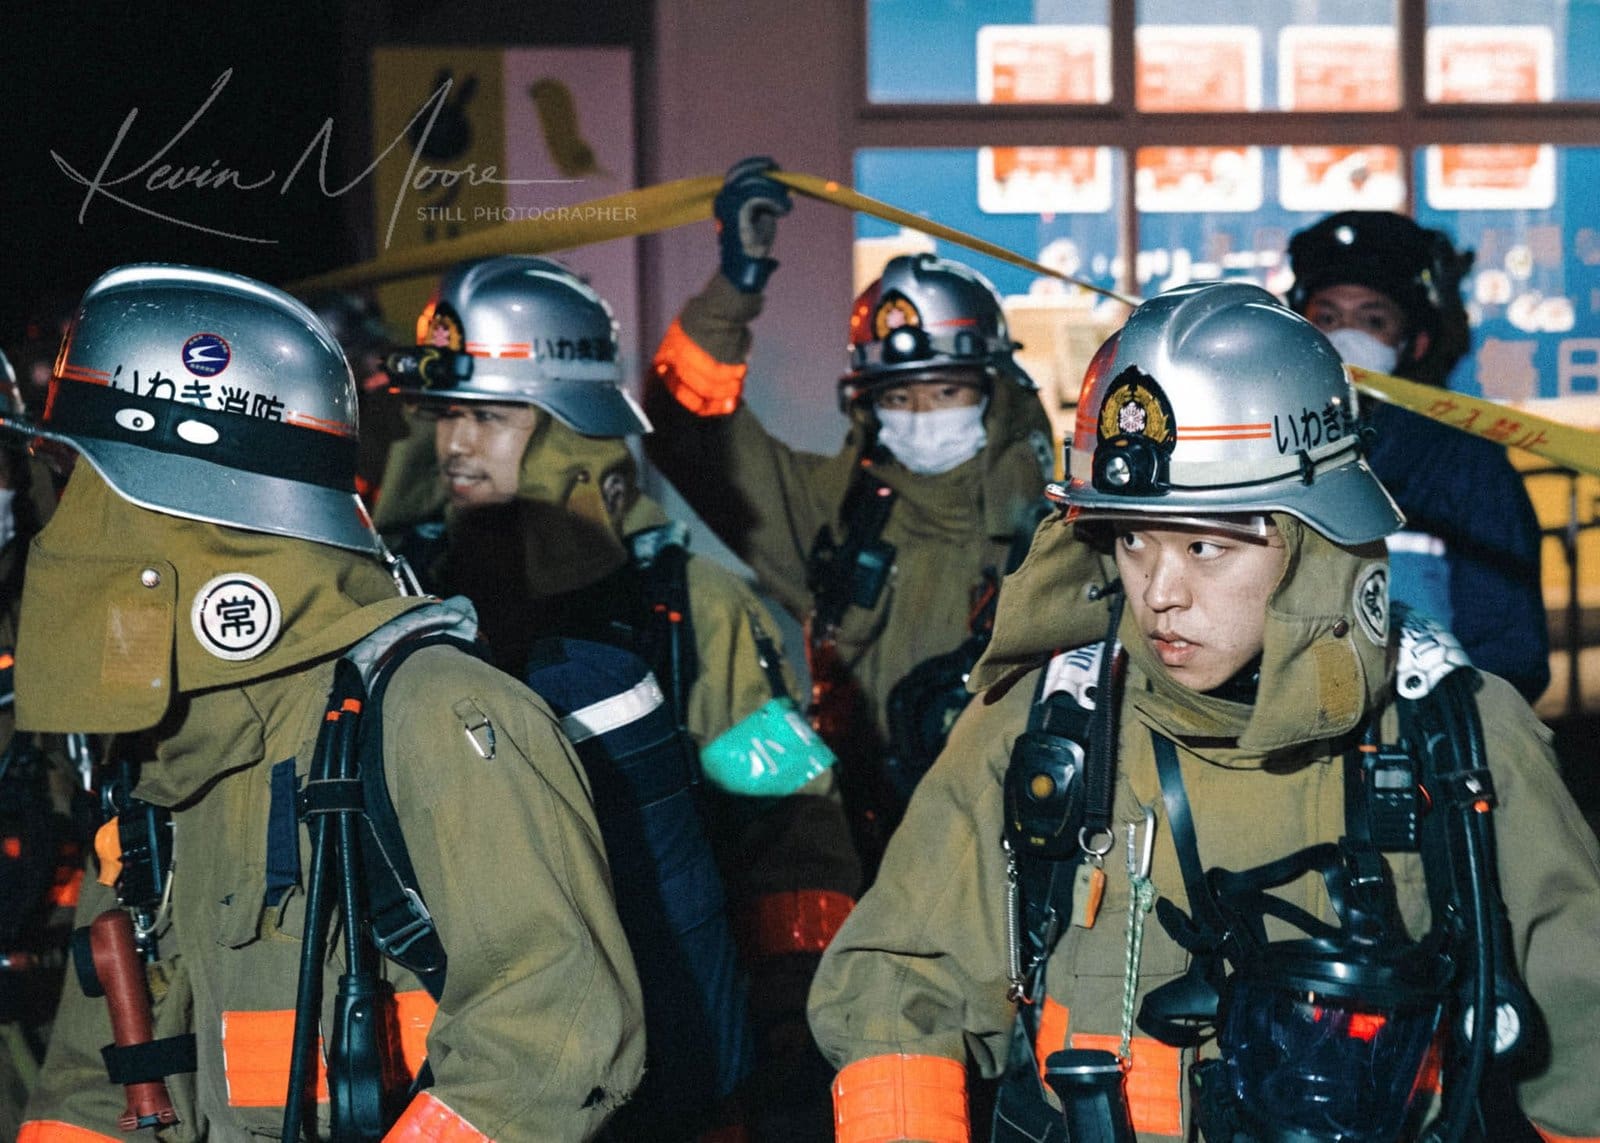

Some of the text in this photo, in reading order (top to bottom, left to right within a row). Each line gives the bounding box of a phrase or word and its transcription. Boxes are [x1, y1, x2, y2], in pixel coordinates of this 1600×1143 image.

[1274, 402, 1356, 455] いわき
[215, 595, 256, 638] 常
